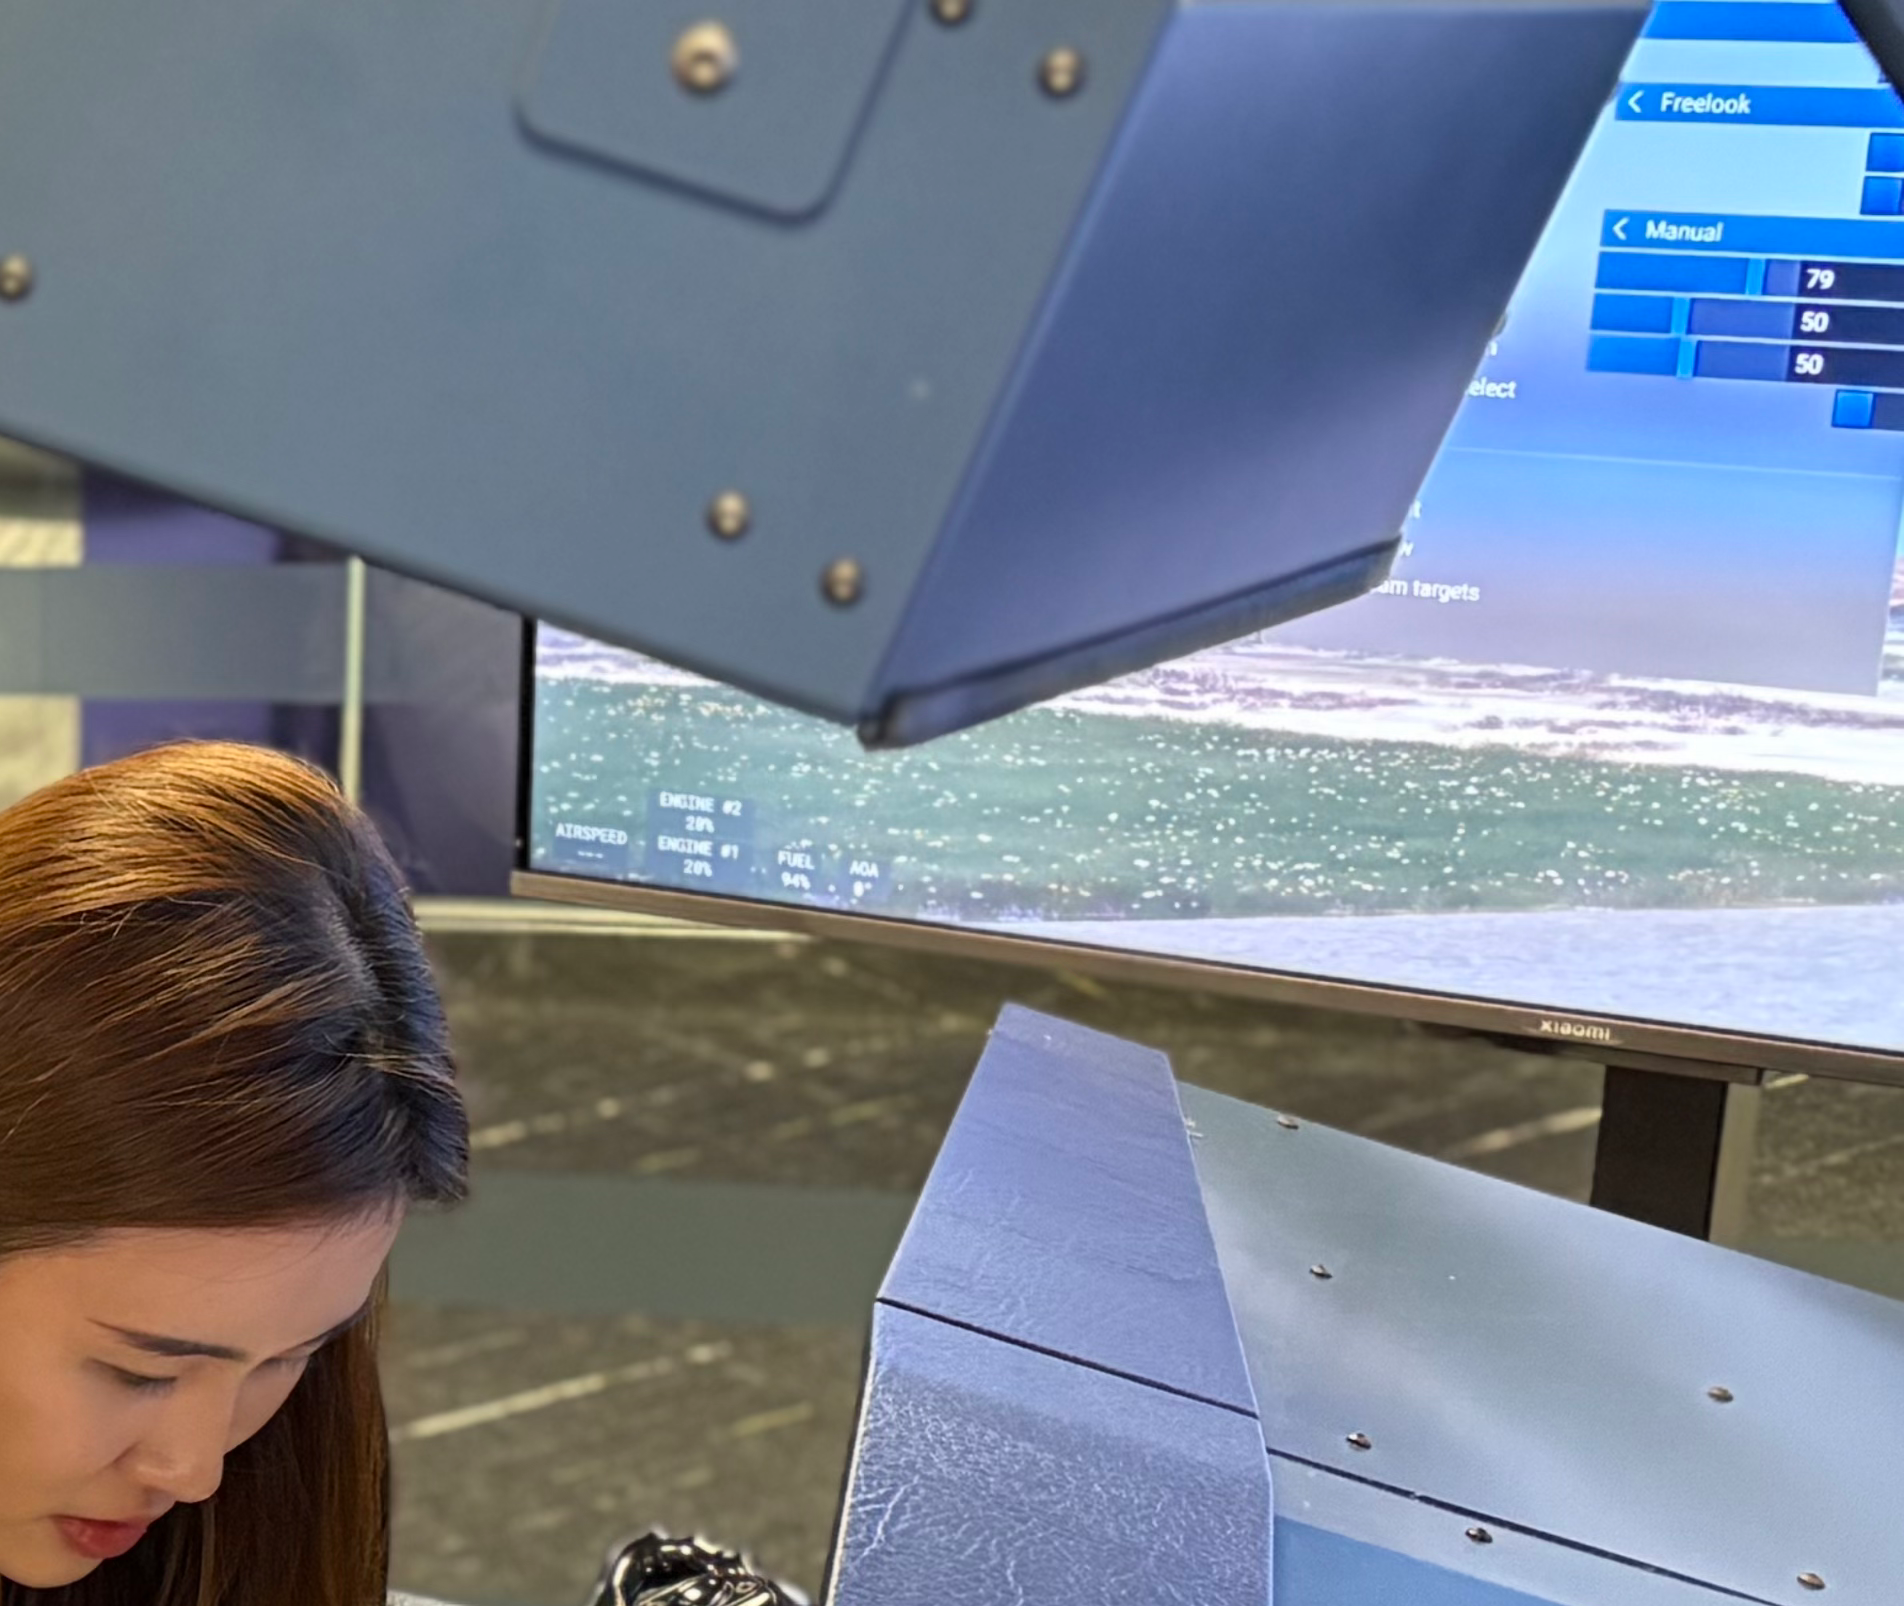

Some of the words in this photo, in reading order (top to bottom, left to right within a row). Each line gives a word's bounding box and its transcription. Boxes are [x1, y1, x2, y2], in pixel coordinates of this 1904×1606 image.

[1660, 91, 1752, 115] Freelook
[1645, 220, 1724, 243] Manual
[1806, 269, 1835, 290] 79
[1800, 312, 1829, 333] 50
[1794, 354, 1823, 375] 50
[1467, 376, 1517, 399] elect
[1413, 580, 1480, 603] targets
[659, 790, 715, 813] ENGINE
[555, 821, 629, 846] AIRSPEED
[657, 835, 713, 857] ENGINE
[778, 849, 815, 870] FUEL
[849, 860, 879, 878] AOA
